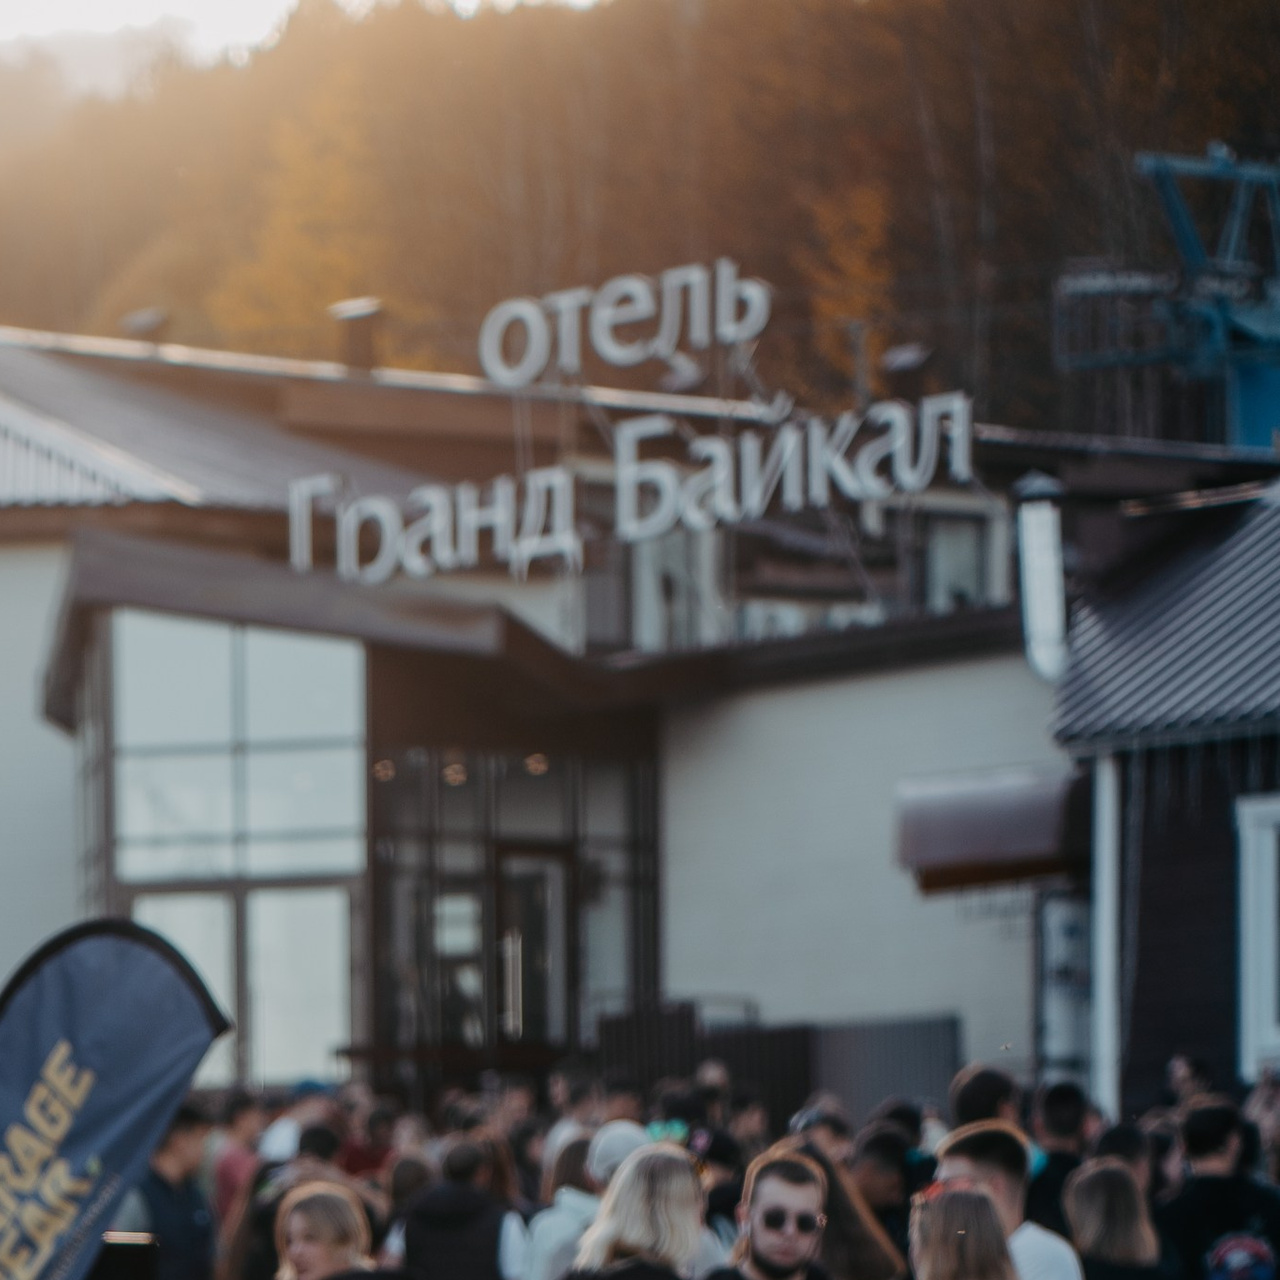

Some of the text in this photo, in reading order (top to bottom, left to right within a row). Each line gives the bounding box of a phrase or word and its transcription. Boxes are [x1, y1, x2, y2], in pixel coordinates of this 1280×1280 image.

[478, 257, 772, 389] отель
[289, 388, 973, 586] Гранд Байкал
